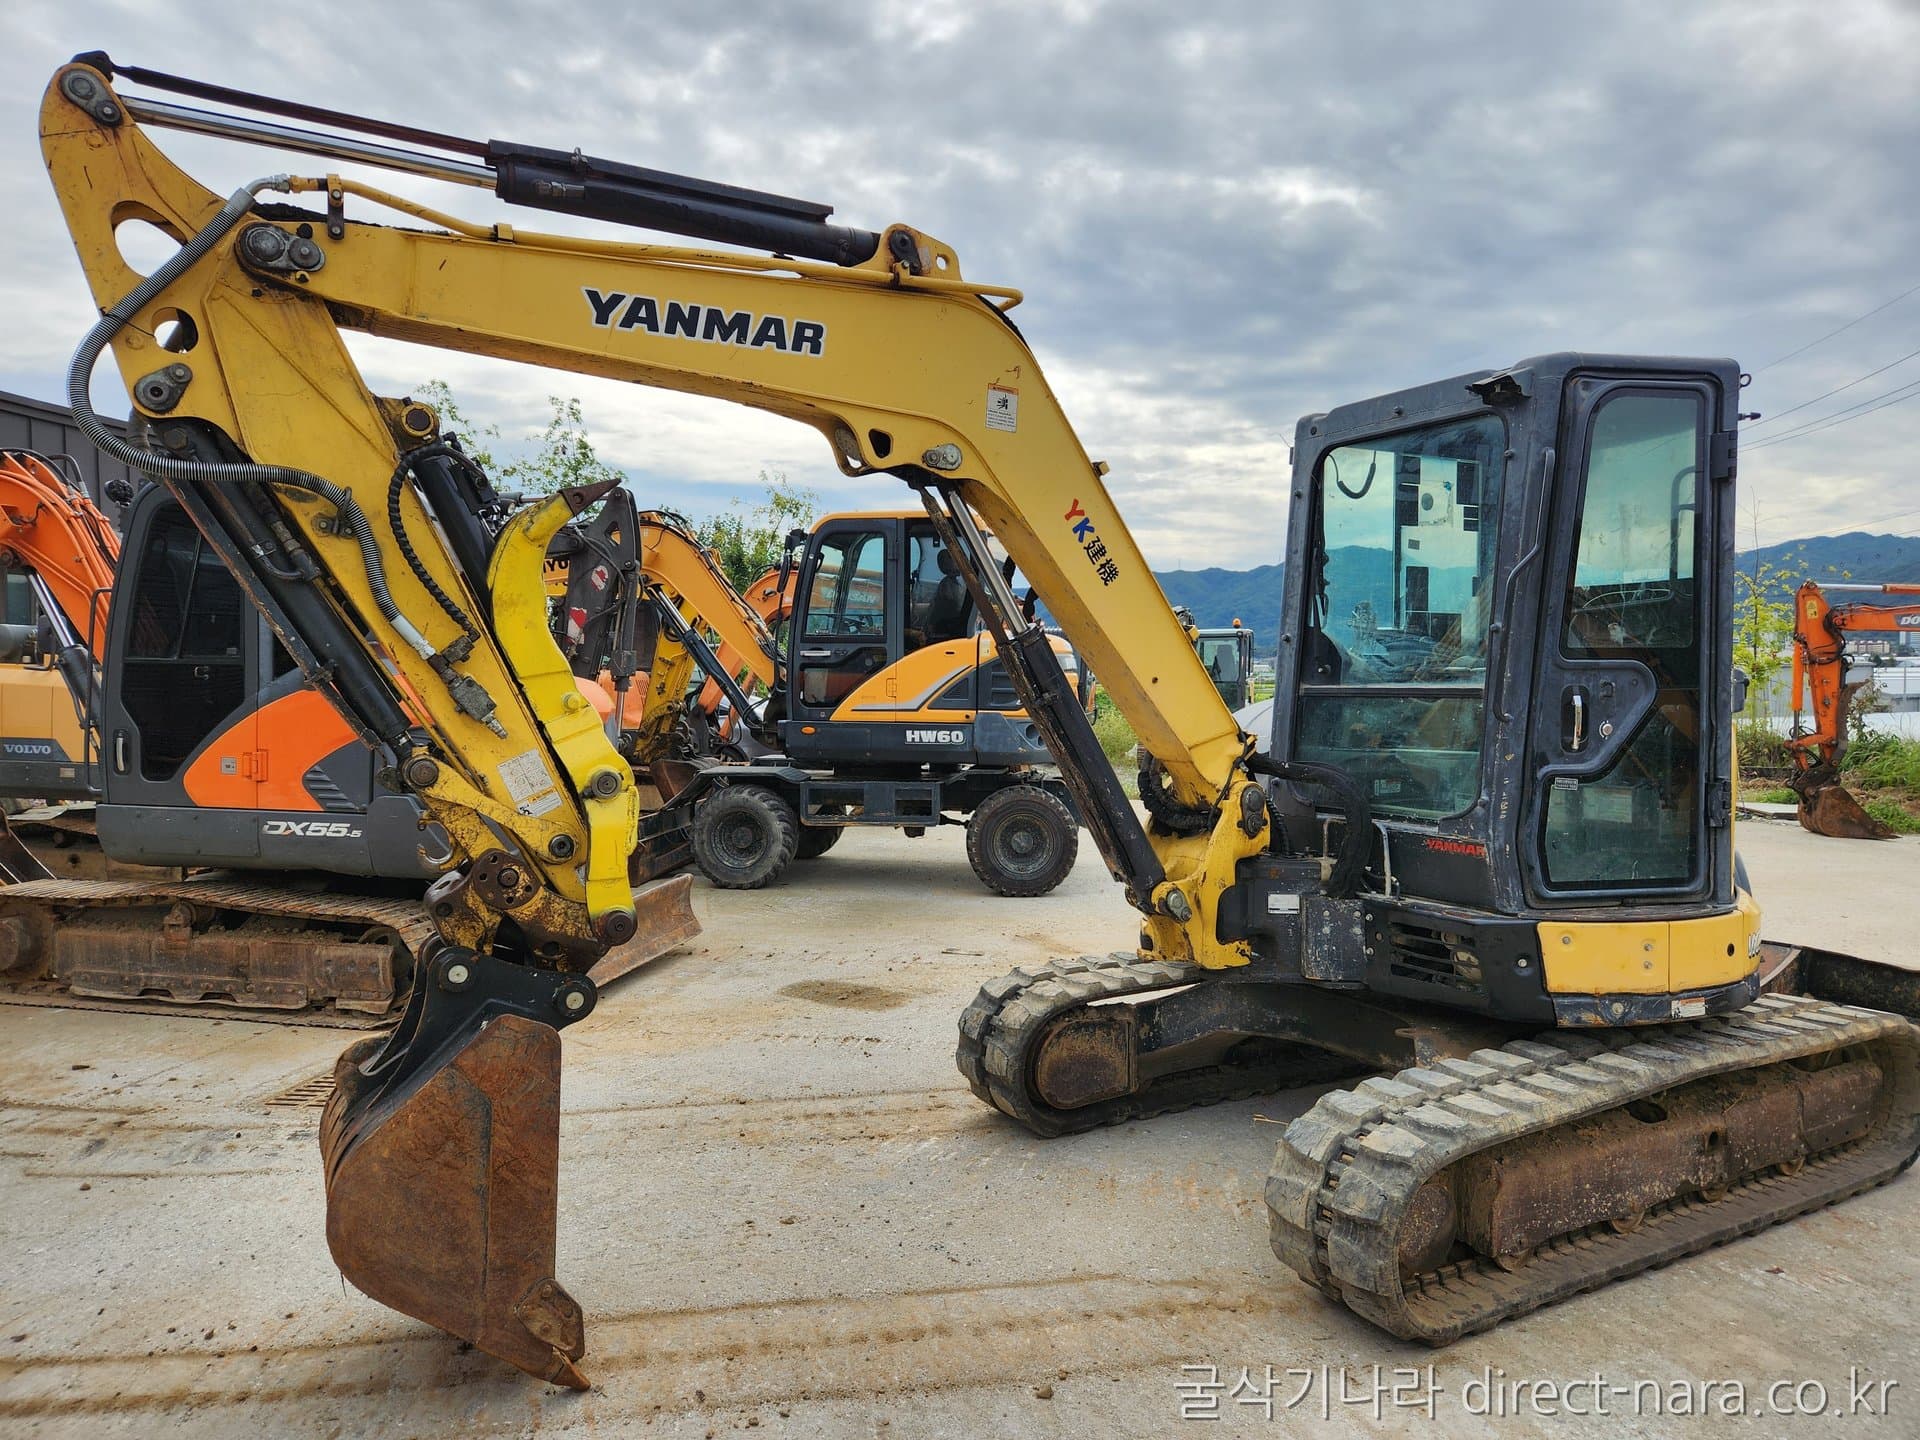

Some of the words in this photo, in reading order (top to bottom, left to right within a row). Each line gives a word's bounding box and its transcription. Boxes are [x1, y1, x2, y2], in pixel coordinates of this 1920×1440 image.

[582, 287, 825, 356] YANMAR
[905, 729, 965, 744] HW60
[3, 744, 51, 754] VOLVO
[1424, 838, 1487, 858] YANMAR
